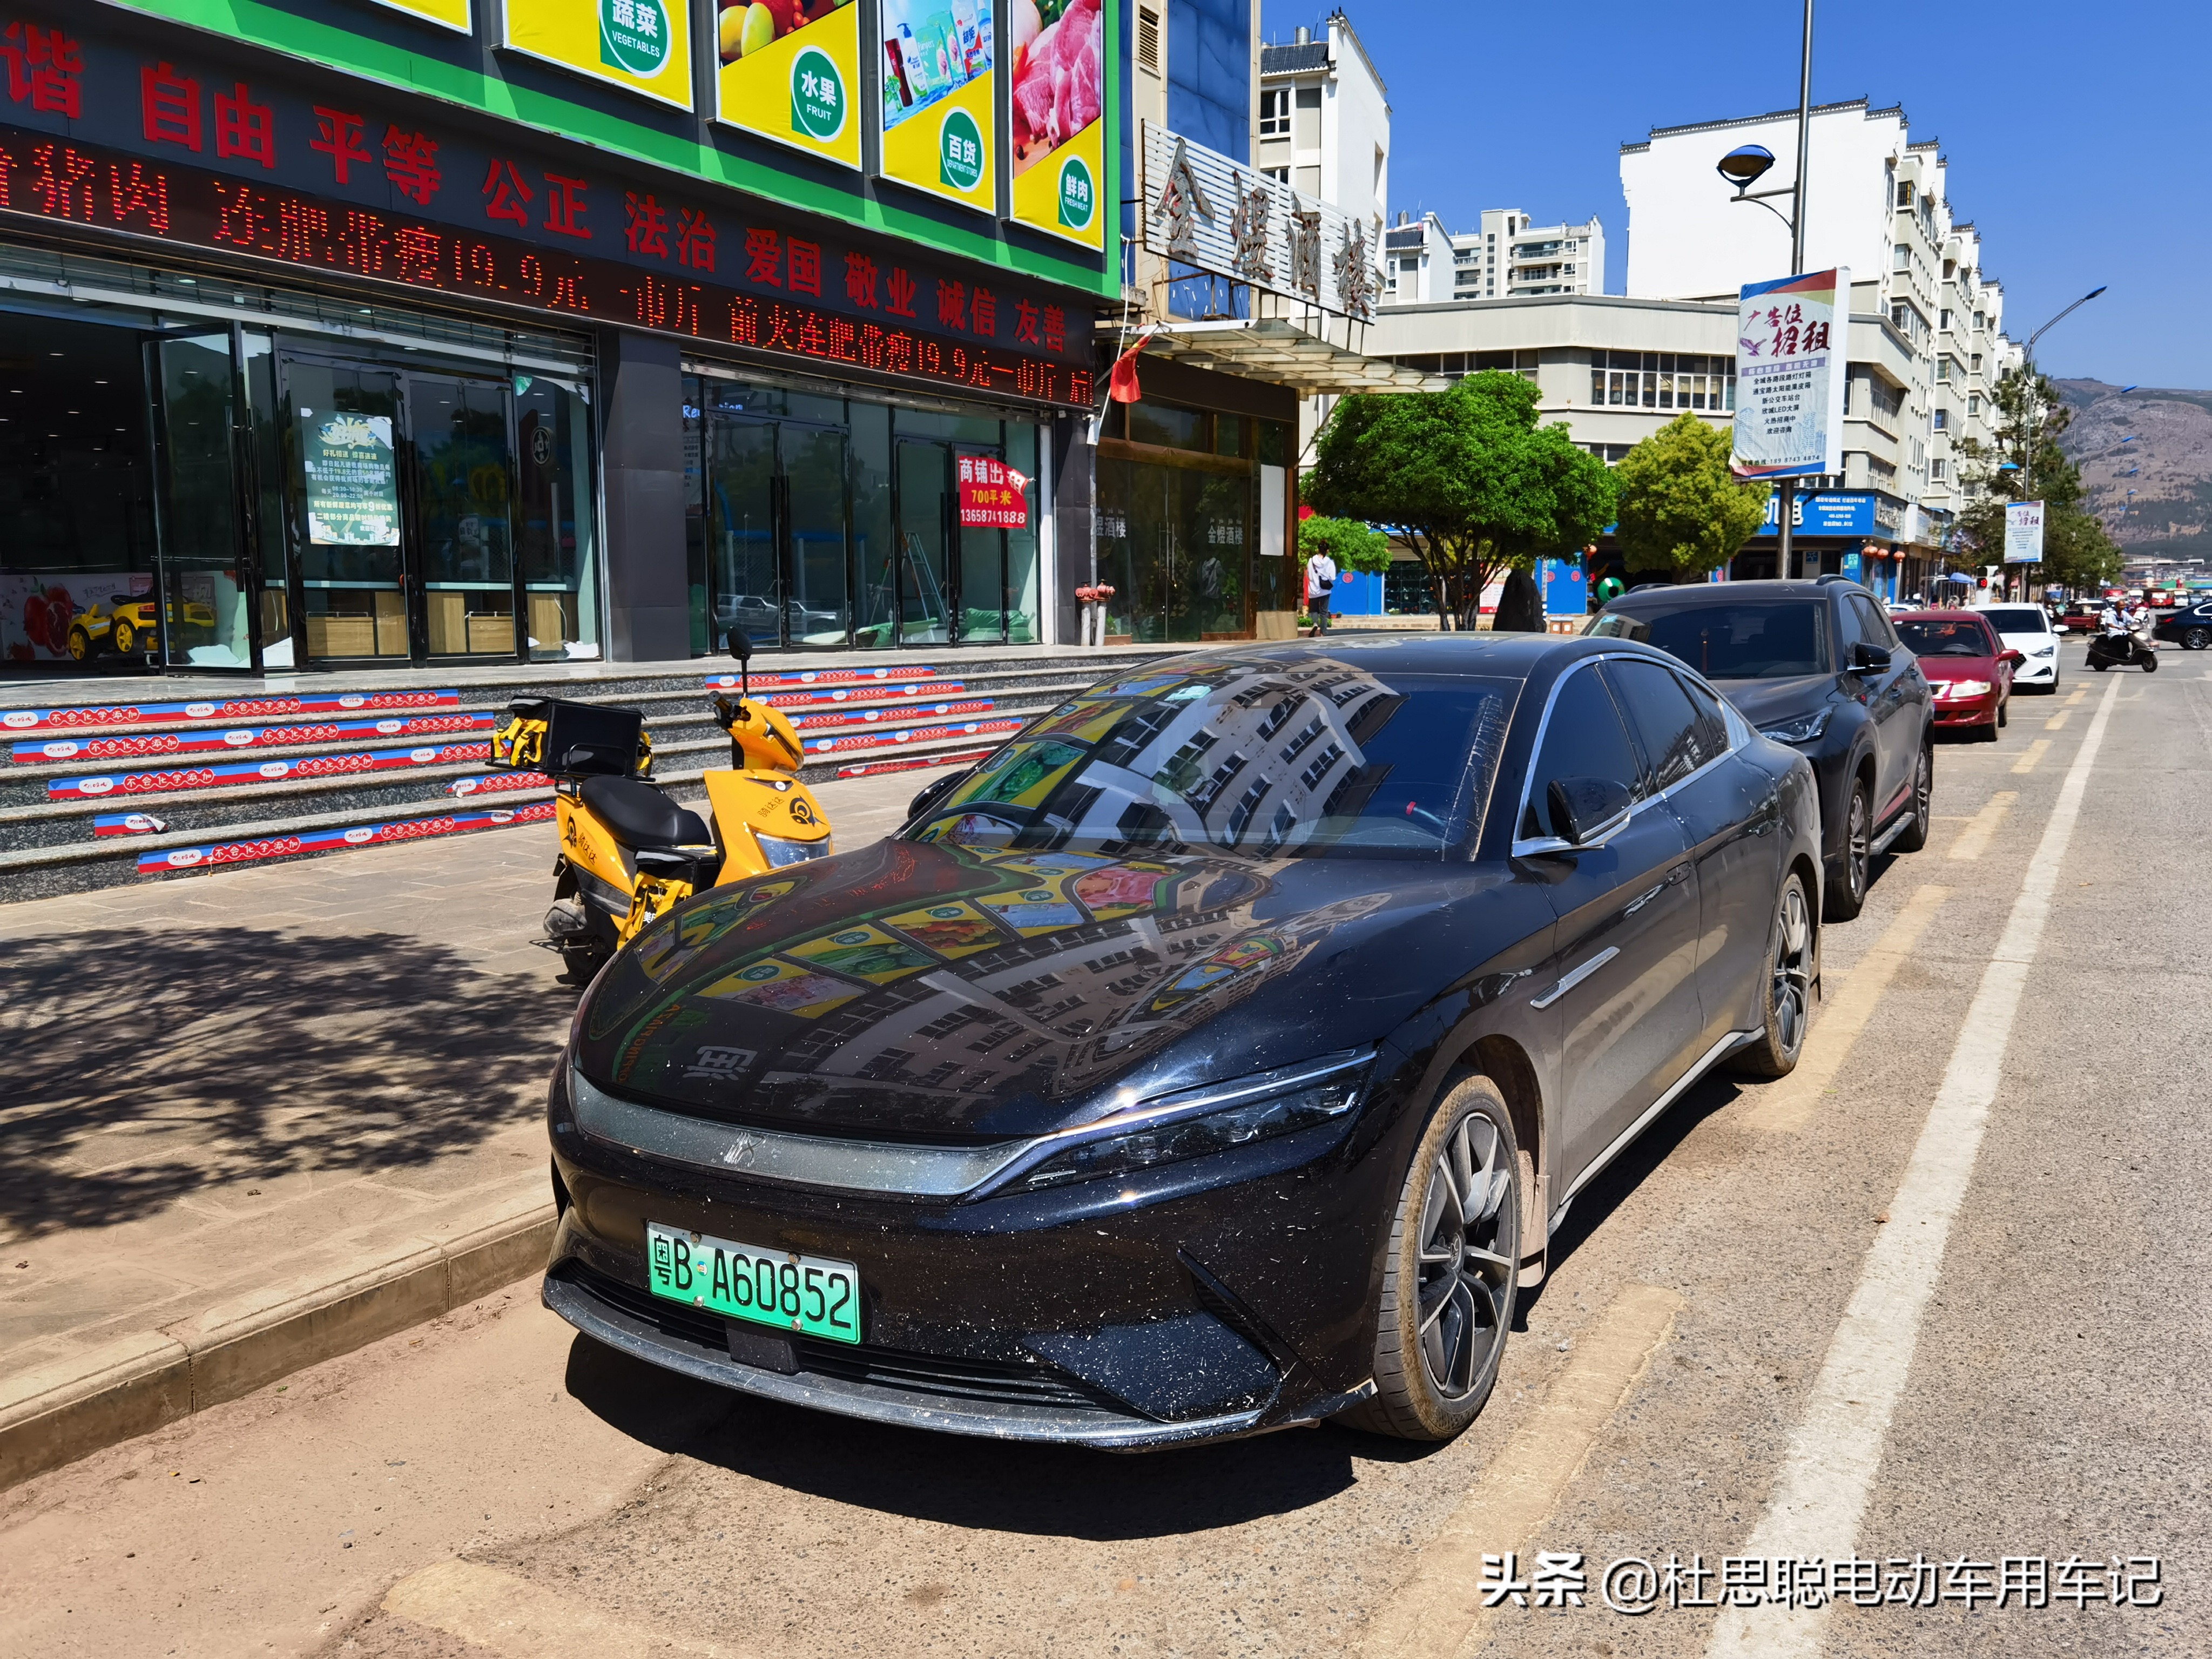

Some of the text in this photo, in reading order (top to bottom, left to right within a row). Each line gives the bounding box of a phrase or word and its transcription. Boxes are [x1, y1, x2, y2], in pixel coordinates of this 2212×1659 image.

[612, 0, 658, 38] 蔬菜
[611, 30, 660, 57] VEGETABLES
[801, 70, 837, 108] 水果
[806, 103, 832, 122] FRUIT
[948, 133, 976, 166] 百货
[947, 158, 977, 178] DEPARTMENT STORES
[0, 22, 1066, 352] 谐 自由 平等 公正 法治 爱国 敬业 诚信 友善
[1065, 173, 1088, 202] 鲜肉
[1064, 196, 1088, 212] FRESH MEAT
[1743, 303, 1803, 332] 广告位
[1770, 320, 1831, 358] 招租
[1762, 394, 1800, 404] 新公交车站台
[1764, 415, 1796, 426] 火热招商中
[1766, 426, 1792, 435] 欢迎咨询
[971, 489, 1012, 506] 700平米
[960, 509, 1026, 524] 13658741888
[225, 697, 300, 713] 不会化学添加
[374, 693, 436, 705] 不会化学添加
[51, 708, 139, 724] 不会化学添加
[265, 725, 338, 740] 不会化学添加
[91, 736, 178, 753] 不会化学添加
[299, 755, 373, 773] 不会化学添加
[126, 771, 213, 788] 不会化学添加
[757, 797, 785, 818] 骑达达
[382, 817, 454, 838] 不会化学添加
[214, 840, 298, 858] 不会化学添加
[578, 832, 598, 866] 骑达达
